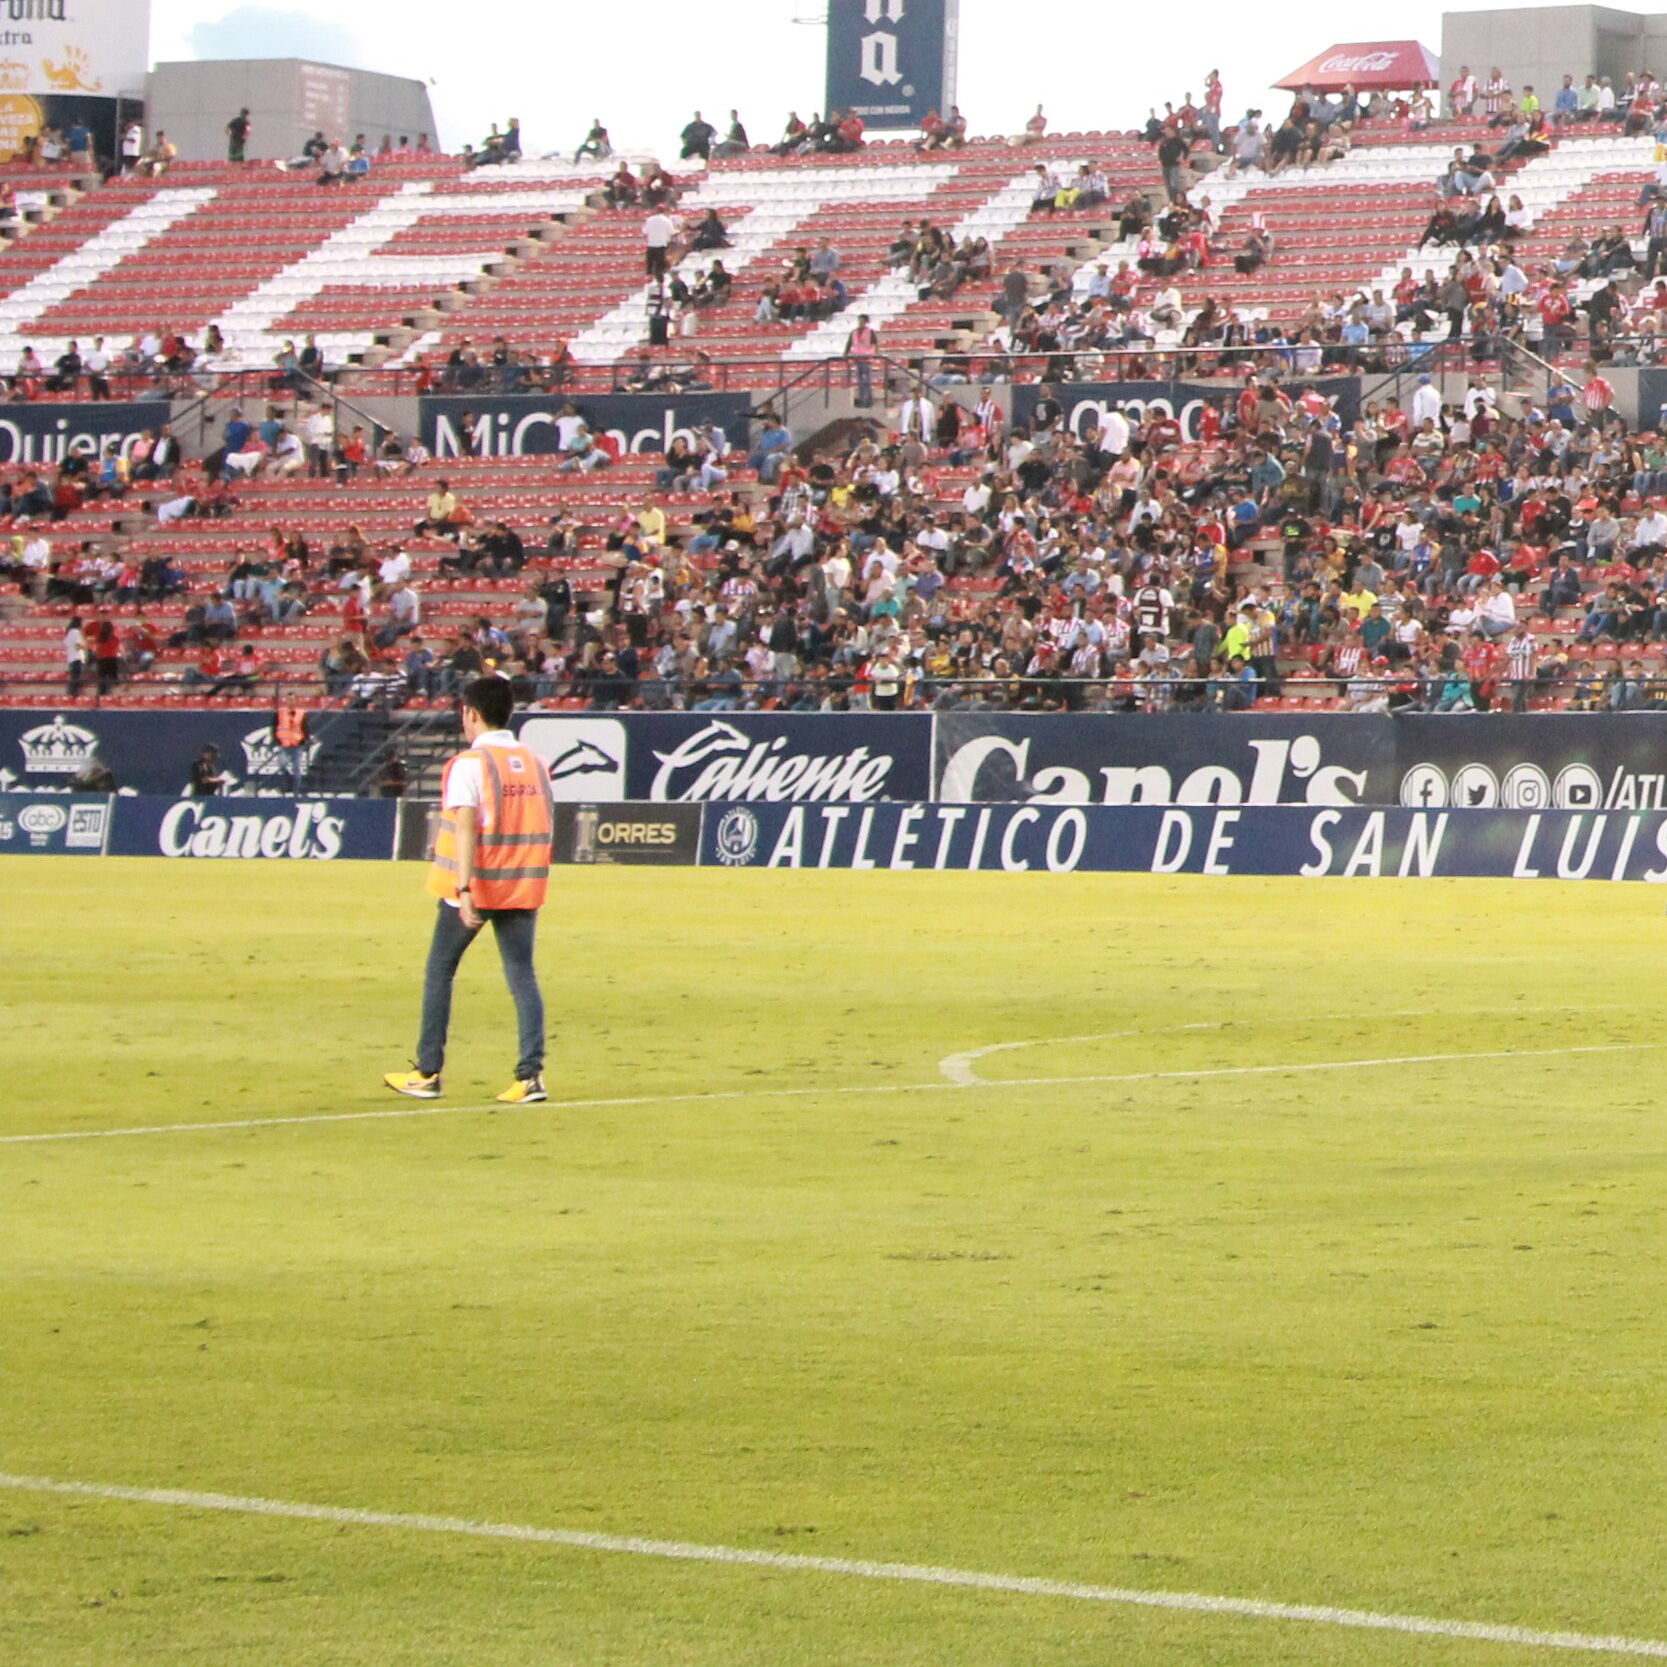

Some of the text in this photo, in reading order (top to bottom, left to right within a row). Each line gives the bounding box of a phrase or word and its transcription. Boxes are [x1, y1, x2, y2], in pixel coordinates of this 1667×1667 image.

[159, 800, 345, 859] Canel's
[766, 802, 1087, 872] ATLÉTICO
[1150, 809, 1242, 874] DE
[1300, 810, 1448, 879] SAN
